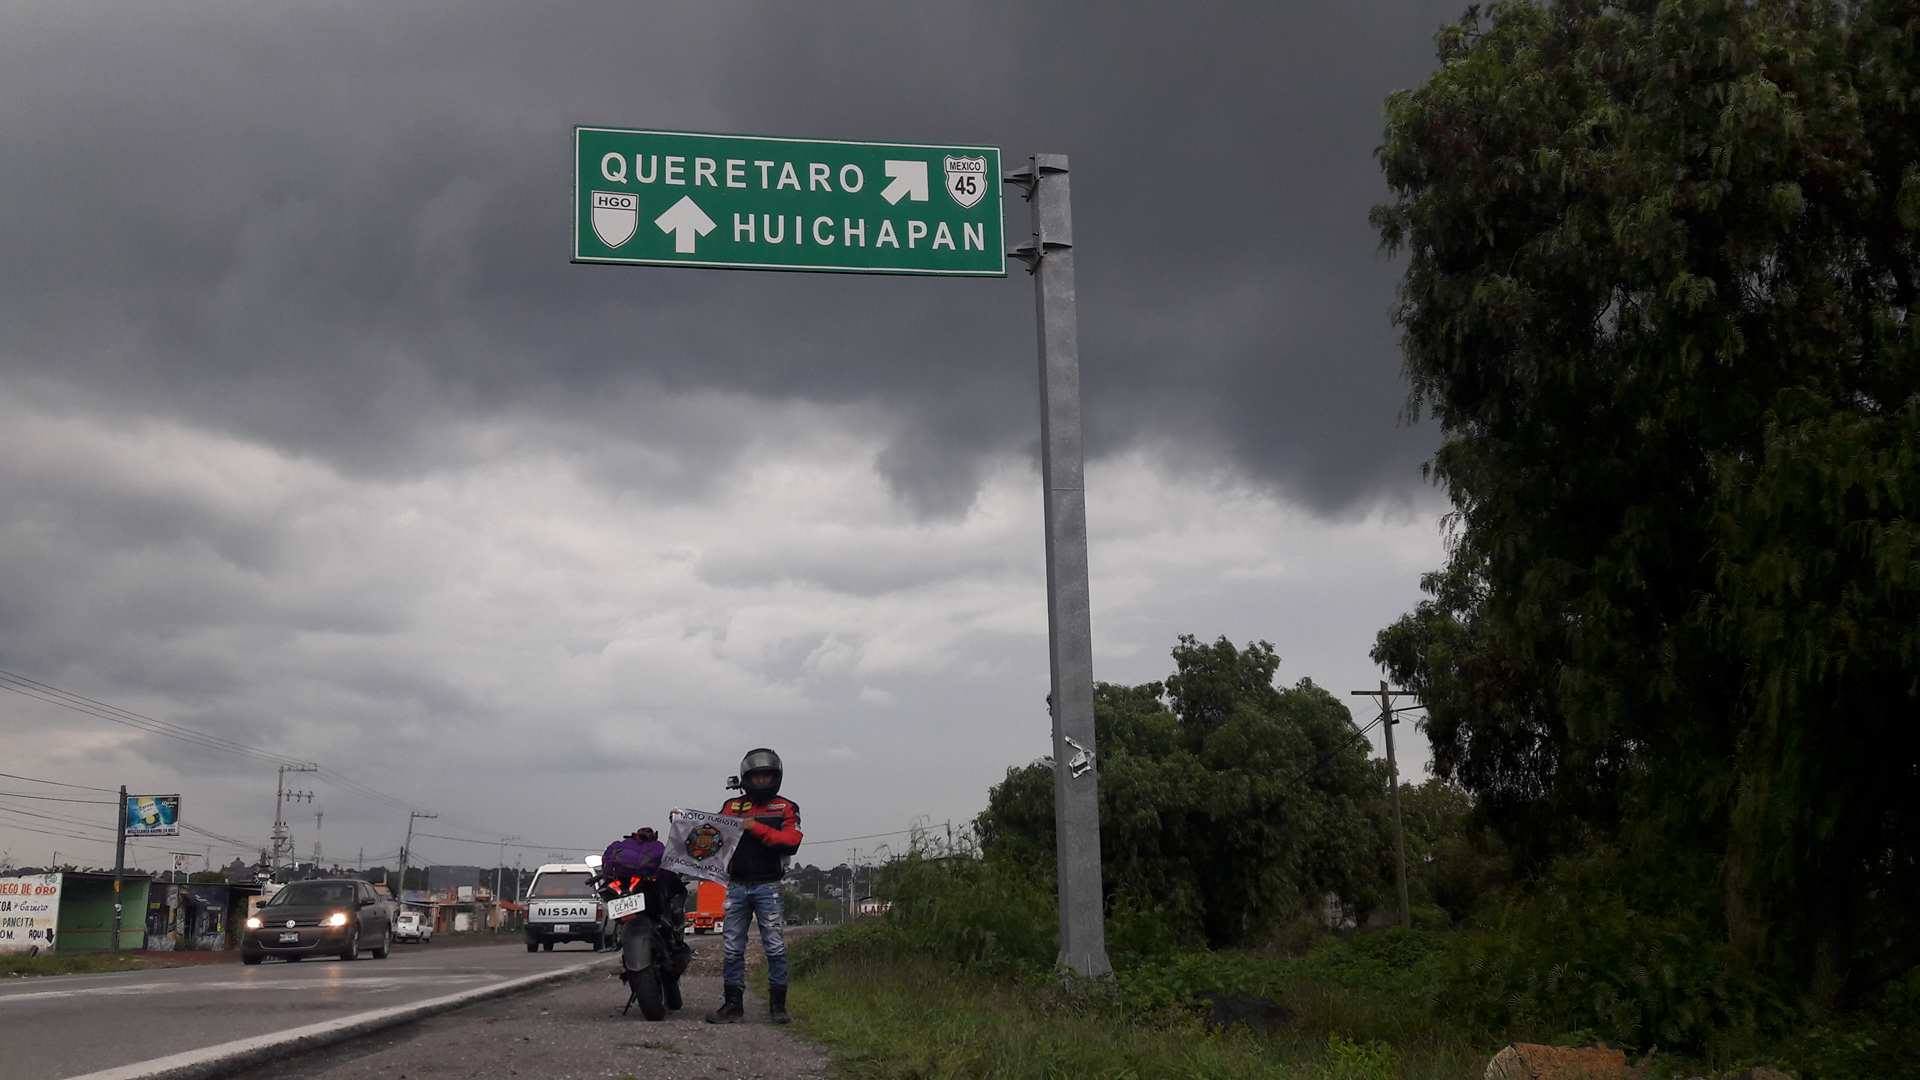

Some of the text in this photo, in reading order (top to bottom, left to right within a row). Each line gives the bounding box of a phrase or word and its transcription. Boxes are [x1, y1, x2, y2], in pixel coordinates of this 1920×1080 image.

[600, 151, 865, 193] QUERETARO
[949, 160, 981, 172] MEXICO
[954, 176, 976, 196] 45
[598, 196, 631, 208] HGO
[733, 213, 985, 251] HUICHAPAN
[21, 883, 32, 895] DE
[0, 901, 12, 912] OA
[537, 907, 588, 917] NISSAN
[2, 916, 34, 928] PANCITA
